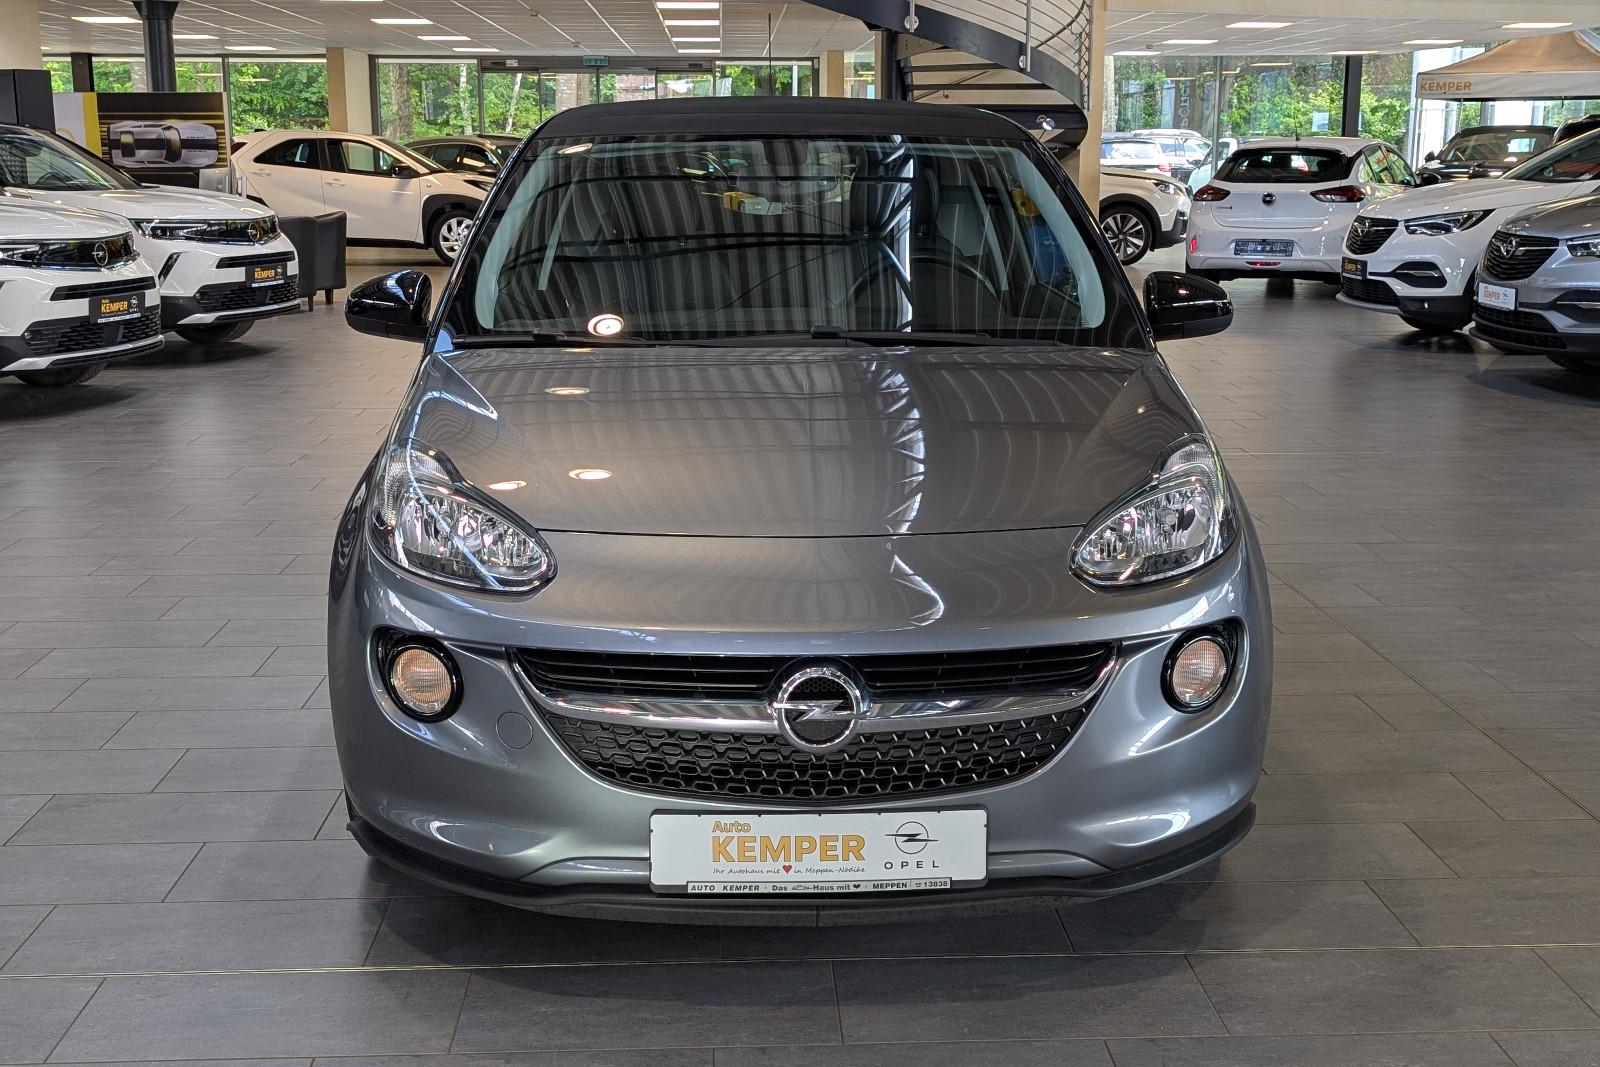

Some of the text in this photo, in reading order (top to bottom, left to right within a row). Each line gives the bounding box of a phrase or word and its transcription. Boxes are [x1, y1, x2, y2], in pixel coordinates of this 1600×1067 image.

[1420, 81, 1472, 92] KEMPER
[101, 301, 128, 312] KEMPER
[712, 820, 751, 833] Auto
[711, 834, 866, 862] KEMPER
[884, 860, 940, 870] OPEL
[690, 884, 716, 892] AUTO
[722, 884, 760, 892] KEMPER
[836, 883, 851, 891] mit
[872, 881, 908, 890] MEPPEN
